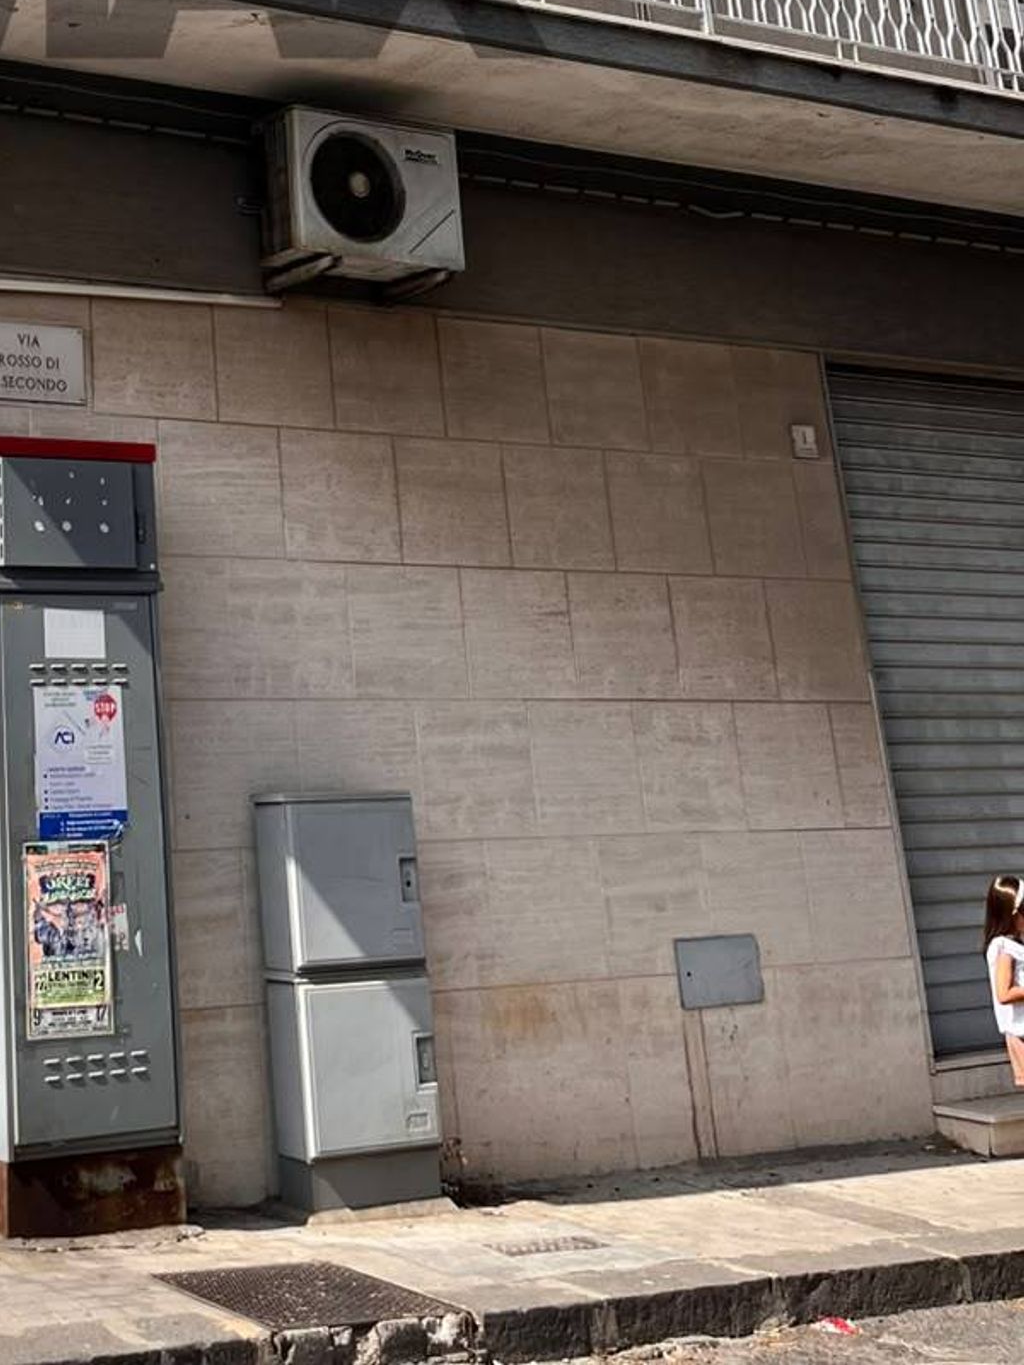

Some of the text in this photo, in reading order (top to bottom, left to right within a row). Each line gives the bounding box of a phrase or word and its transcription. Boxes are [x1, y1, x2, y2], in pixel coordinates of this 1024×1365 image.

[17, 332, 40, 349] VIA
[46, 356, 60, 370] DI
[54, 730, 75, 745] ACI
